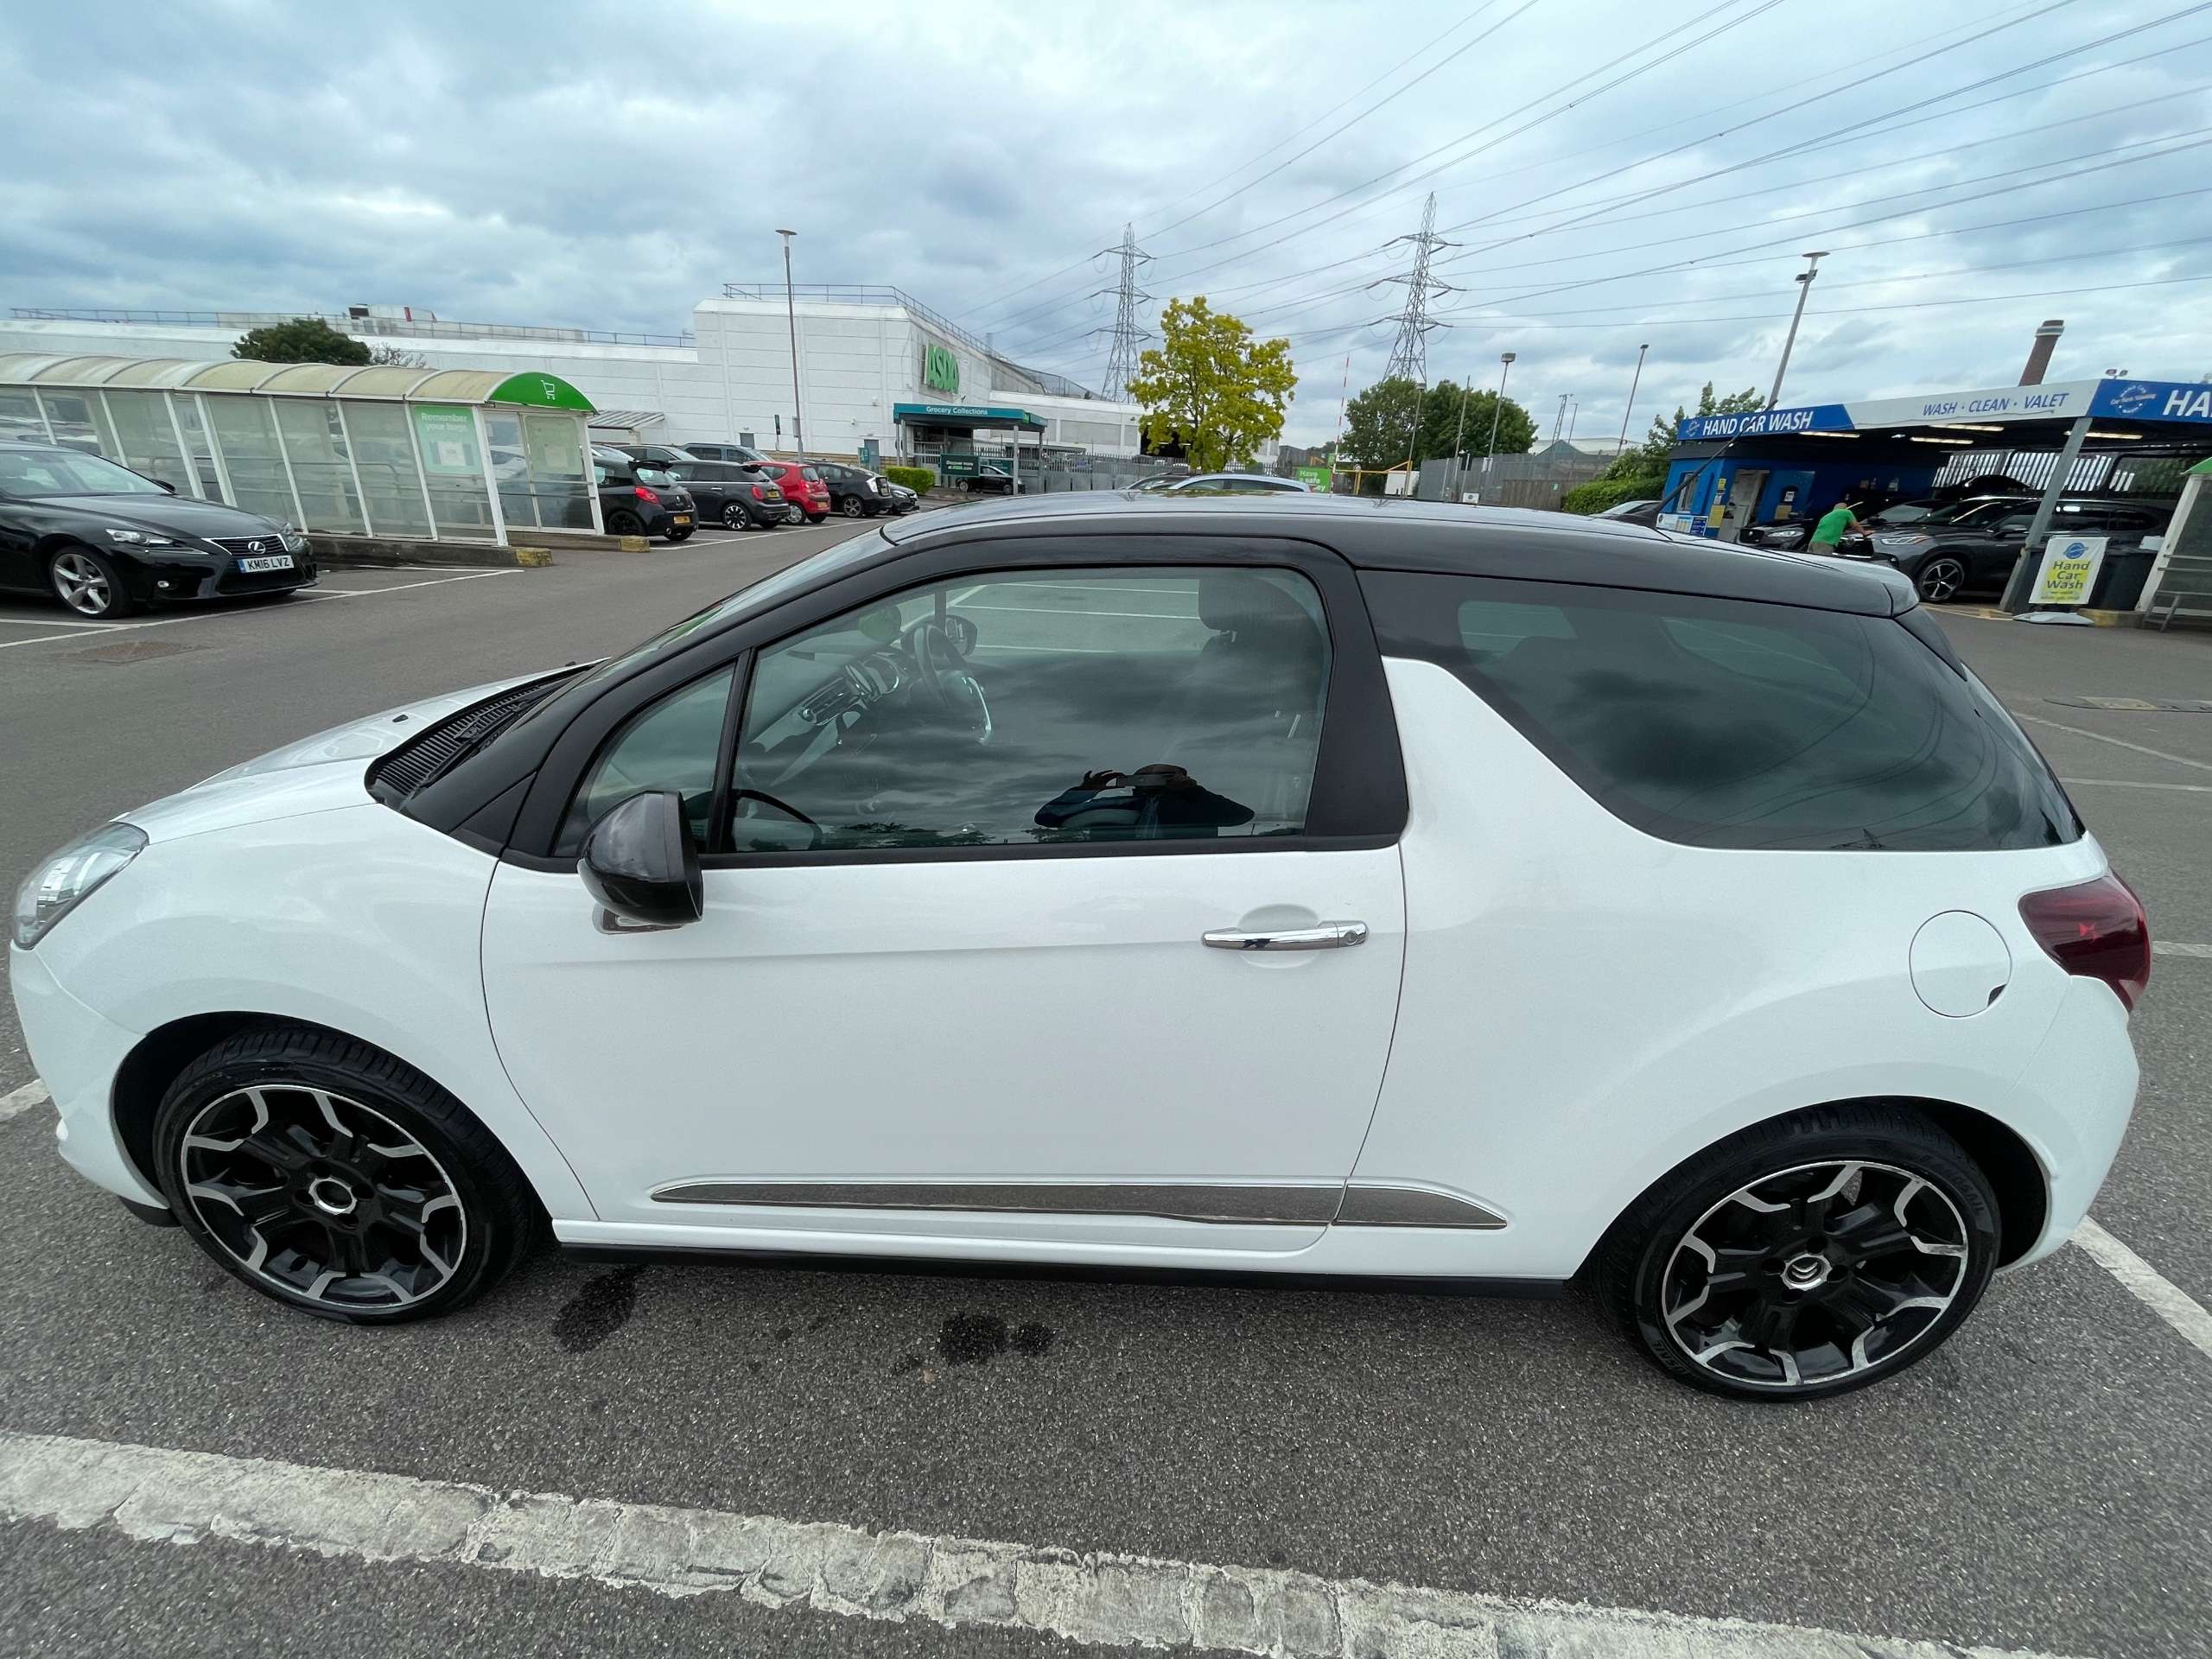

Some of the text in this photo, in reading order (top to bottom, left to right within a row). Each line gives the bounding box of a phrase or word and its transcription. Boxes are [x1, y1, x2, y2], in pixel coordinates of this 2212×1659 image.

[926, 344, 960, 394] ASDA
[1923, 392, 2070, 416] WASH CLEAN VALET
[2162, 389, 2212, 418] HA
[925, 406, 988, 416] Grocery Collections
[421, 412, 467, 422] Remember
[1702, 418, 1738, 436] HAND
[1738, 415, 1766, 432] CAR
[1768, 410, 1815, 431] WASH
[270, 557, 289, 567] LVZ
[2053, 561, 2090, 570] Hand
[2056, 570, 2081, 580] Car
[2047, 581, 2084, 589] Wash
